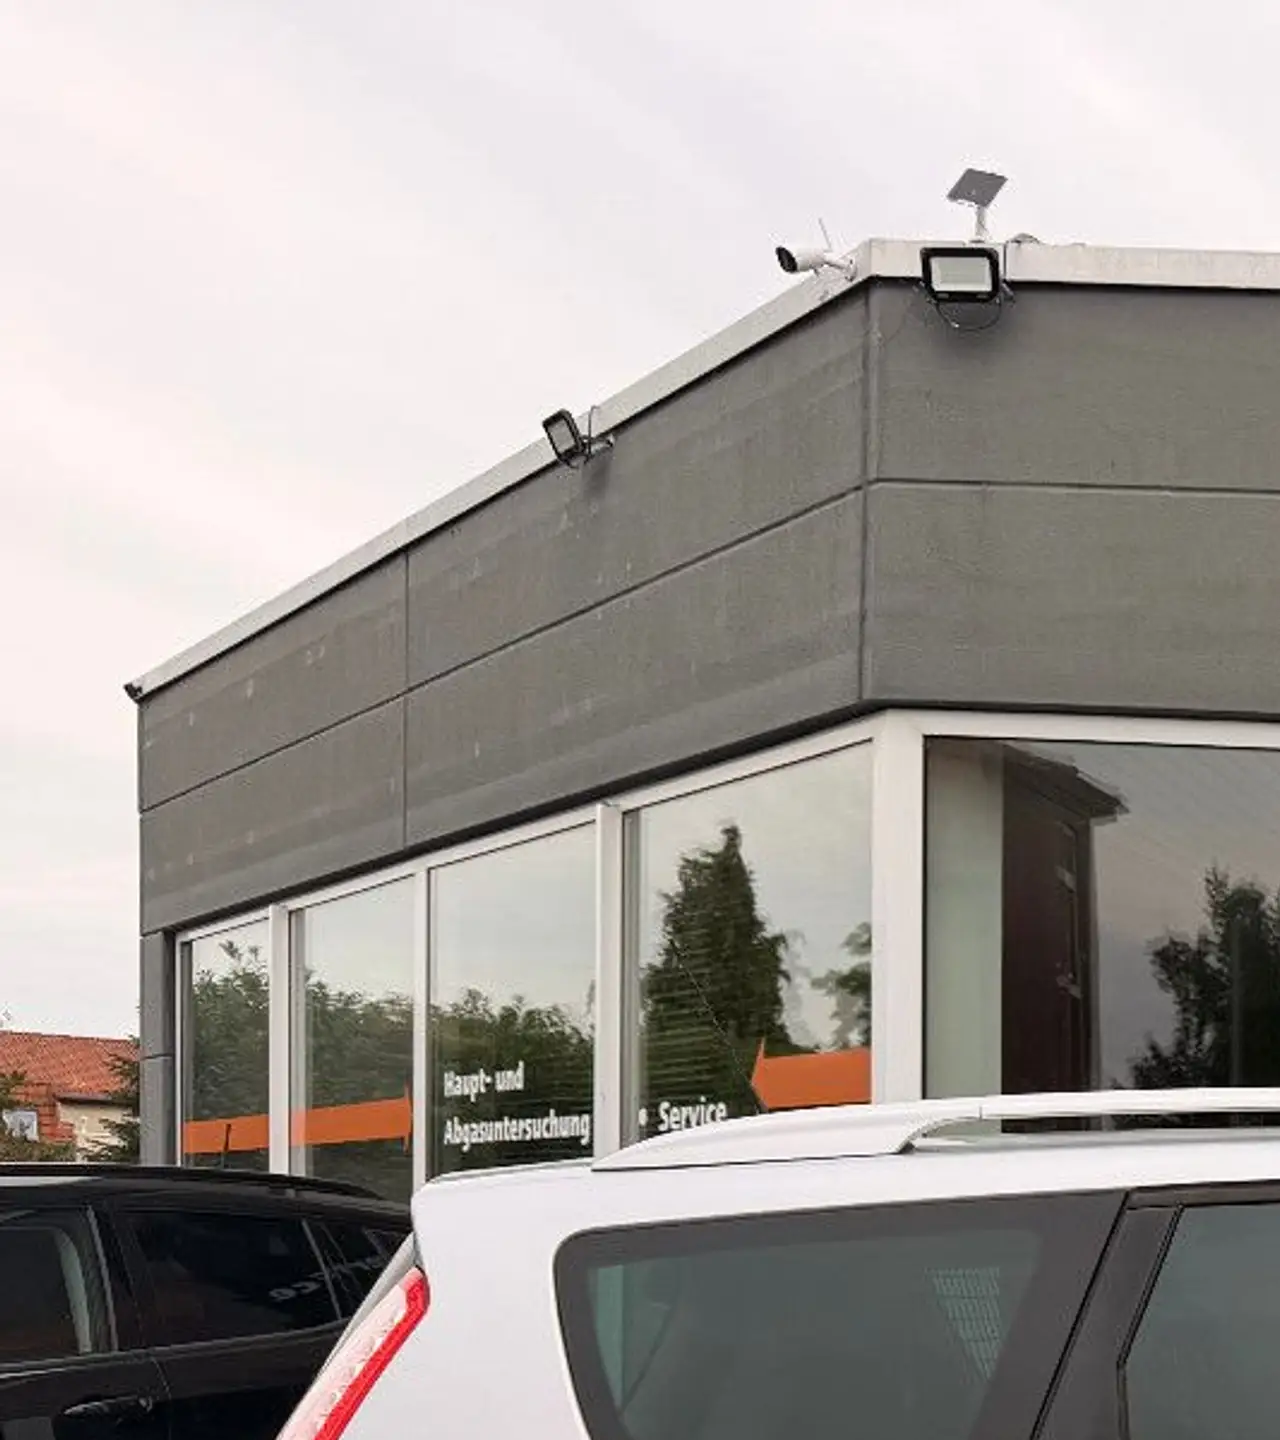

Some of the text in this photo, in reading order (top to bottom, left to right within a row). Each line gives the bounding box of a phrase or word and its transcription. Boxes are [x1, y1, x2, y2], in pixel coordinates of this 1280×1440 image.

[444, 1060, 525, 1102] Haupt- und
[444, 1107, 591, 1152] Abgasuntersuchung
[657, 1096, 729, 1132] Service
